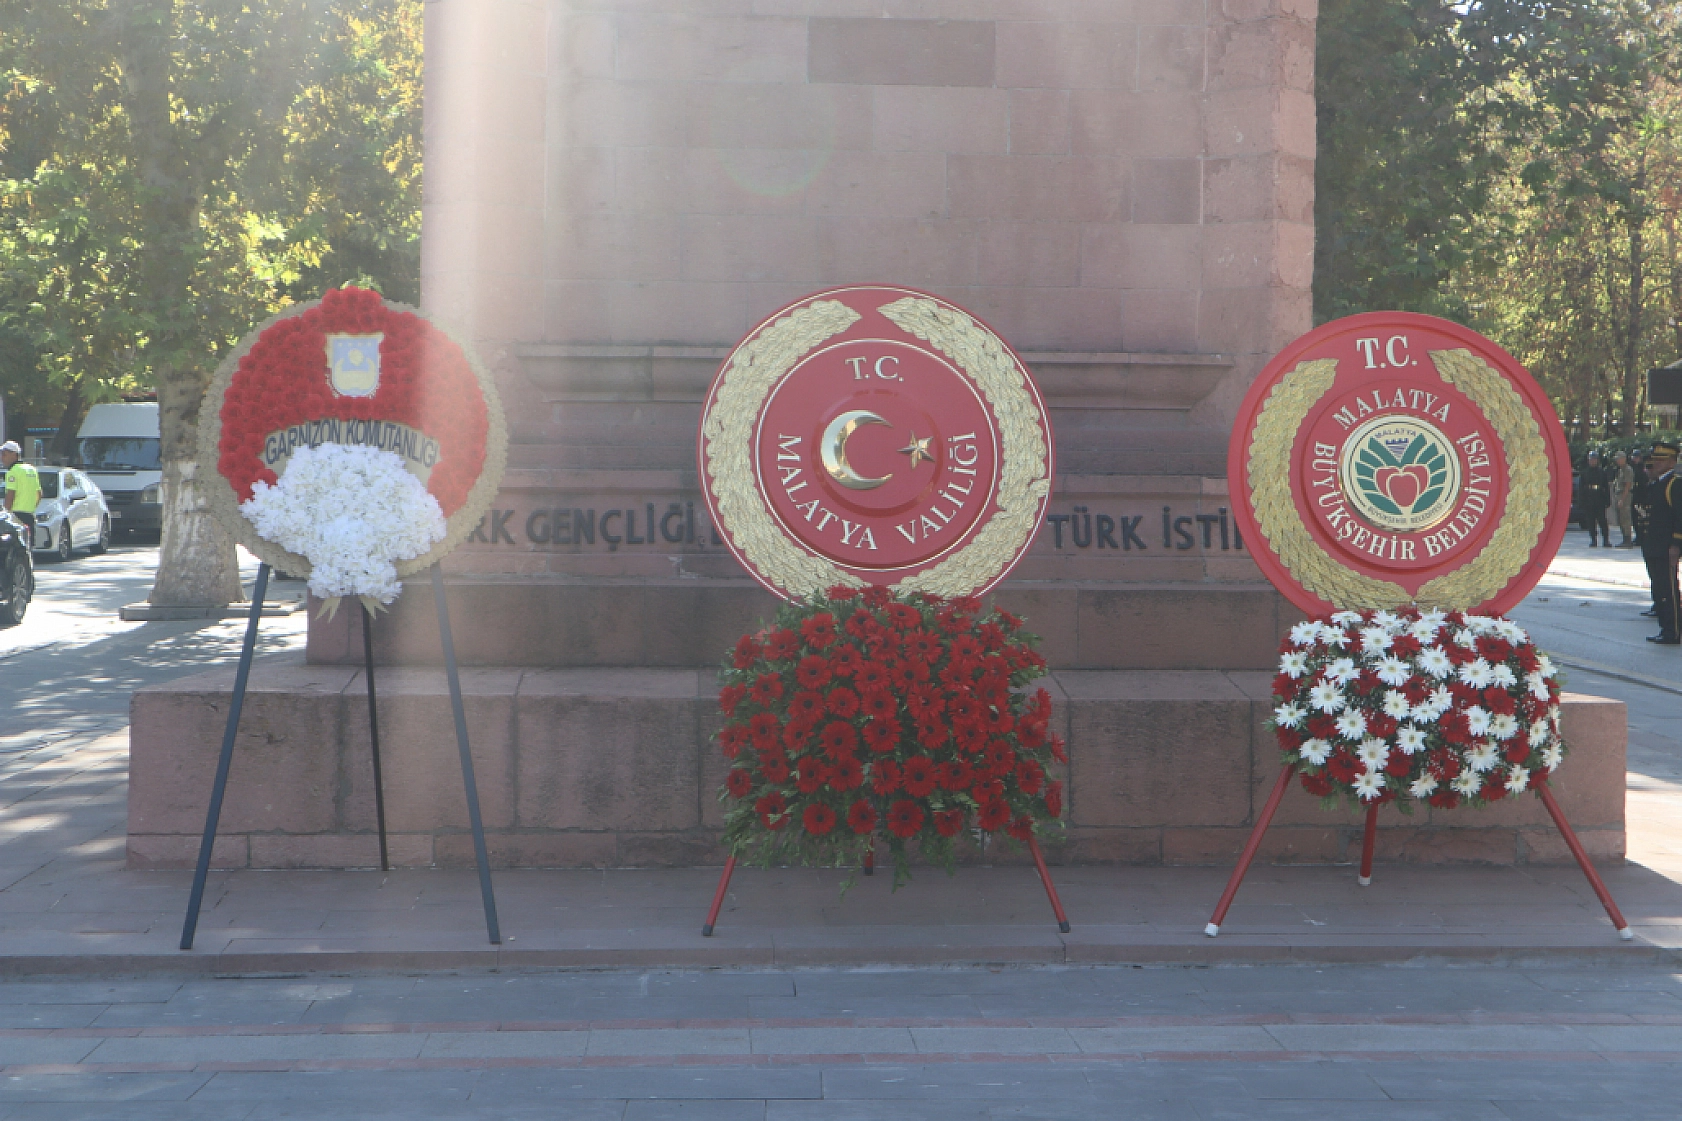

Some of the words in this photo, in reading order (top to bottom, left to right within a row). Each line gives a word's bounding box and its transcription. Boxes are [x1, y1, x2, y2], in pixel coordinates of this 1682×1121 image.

[845, 355, 904, 382] T.C.
[1356, 335, 1418, 369] T.C.
[1332, 387, 1451, 430] MALATYA
[777, 433, 878, 550] MALATYA
[895, 431, 978, 544] VALİLİĞİ
[1312, 441, 1417, 561] BÜYÜKŞEHİR
[1422, 430, 1492, 557] BELEDİYESİ
[1047, 506, 1148, 550] TÜRK
